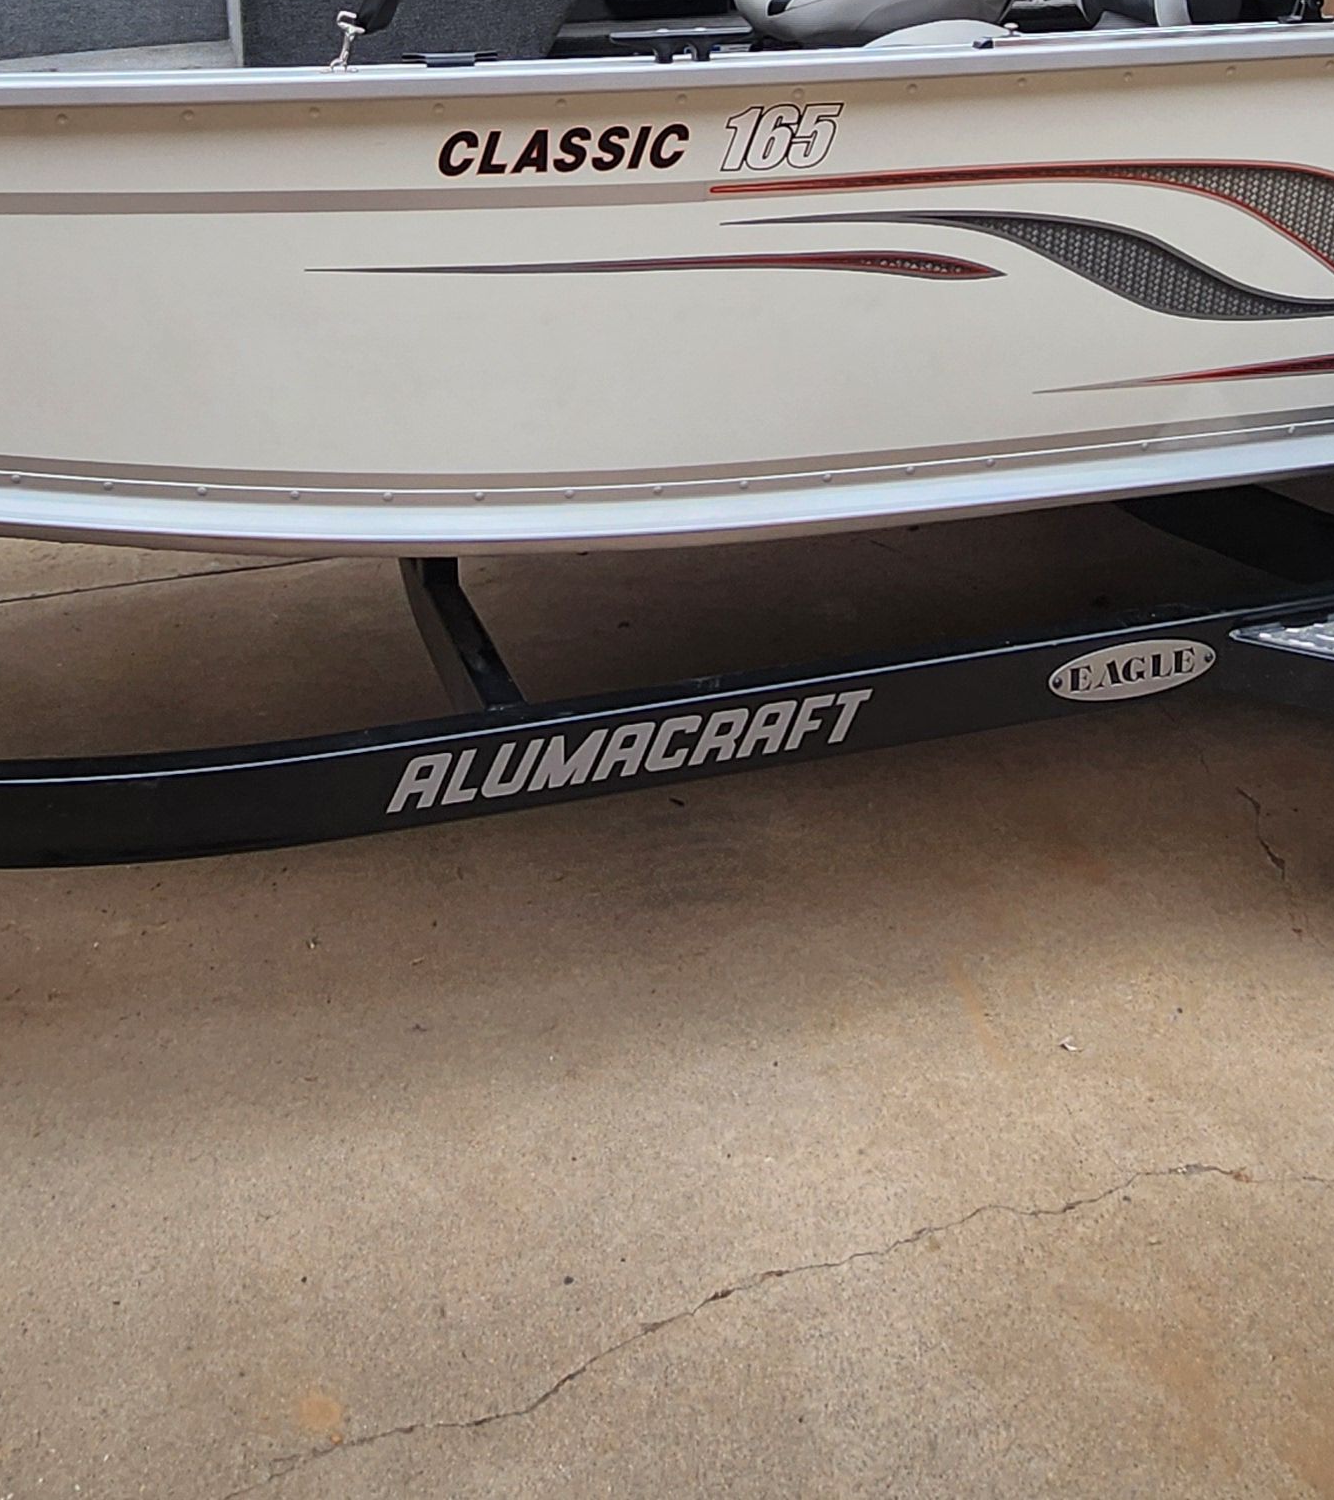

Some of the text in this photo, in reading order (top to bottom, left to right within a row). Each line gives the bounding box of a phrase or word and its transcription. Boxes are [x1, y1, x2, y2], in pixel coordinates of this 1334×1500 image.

[437, 102, 845, 177] CLASSIC 165
[1069, 647, 1196, 693] EAGLE
[385, 688, 874, 814] ALUMACRAFT
